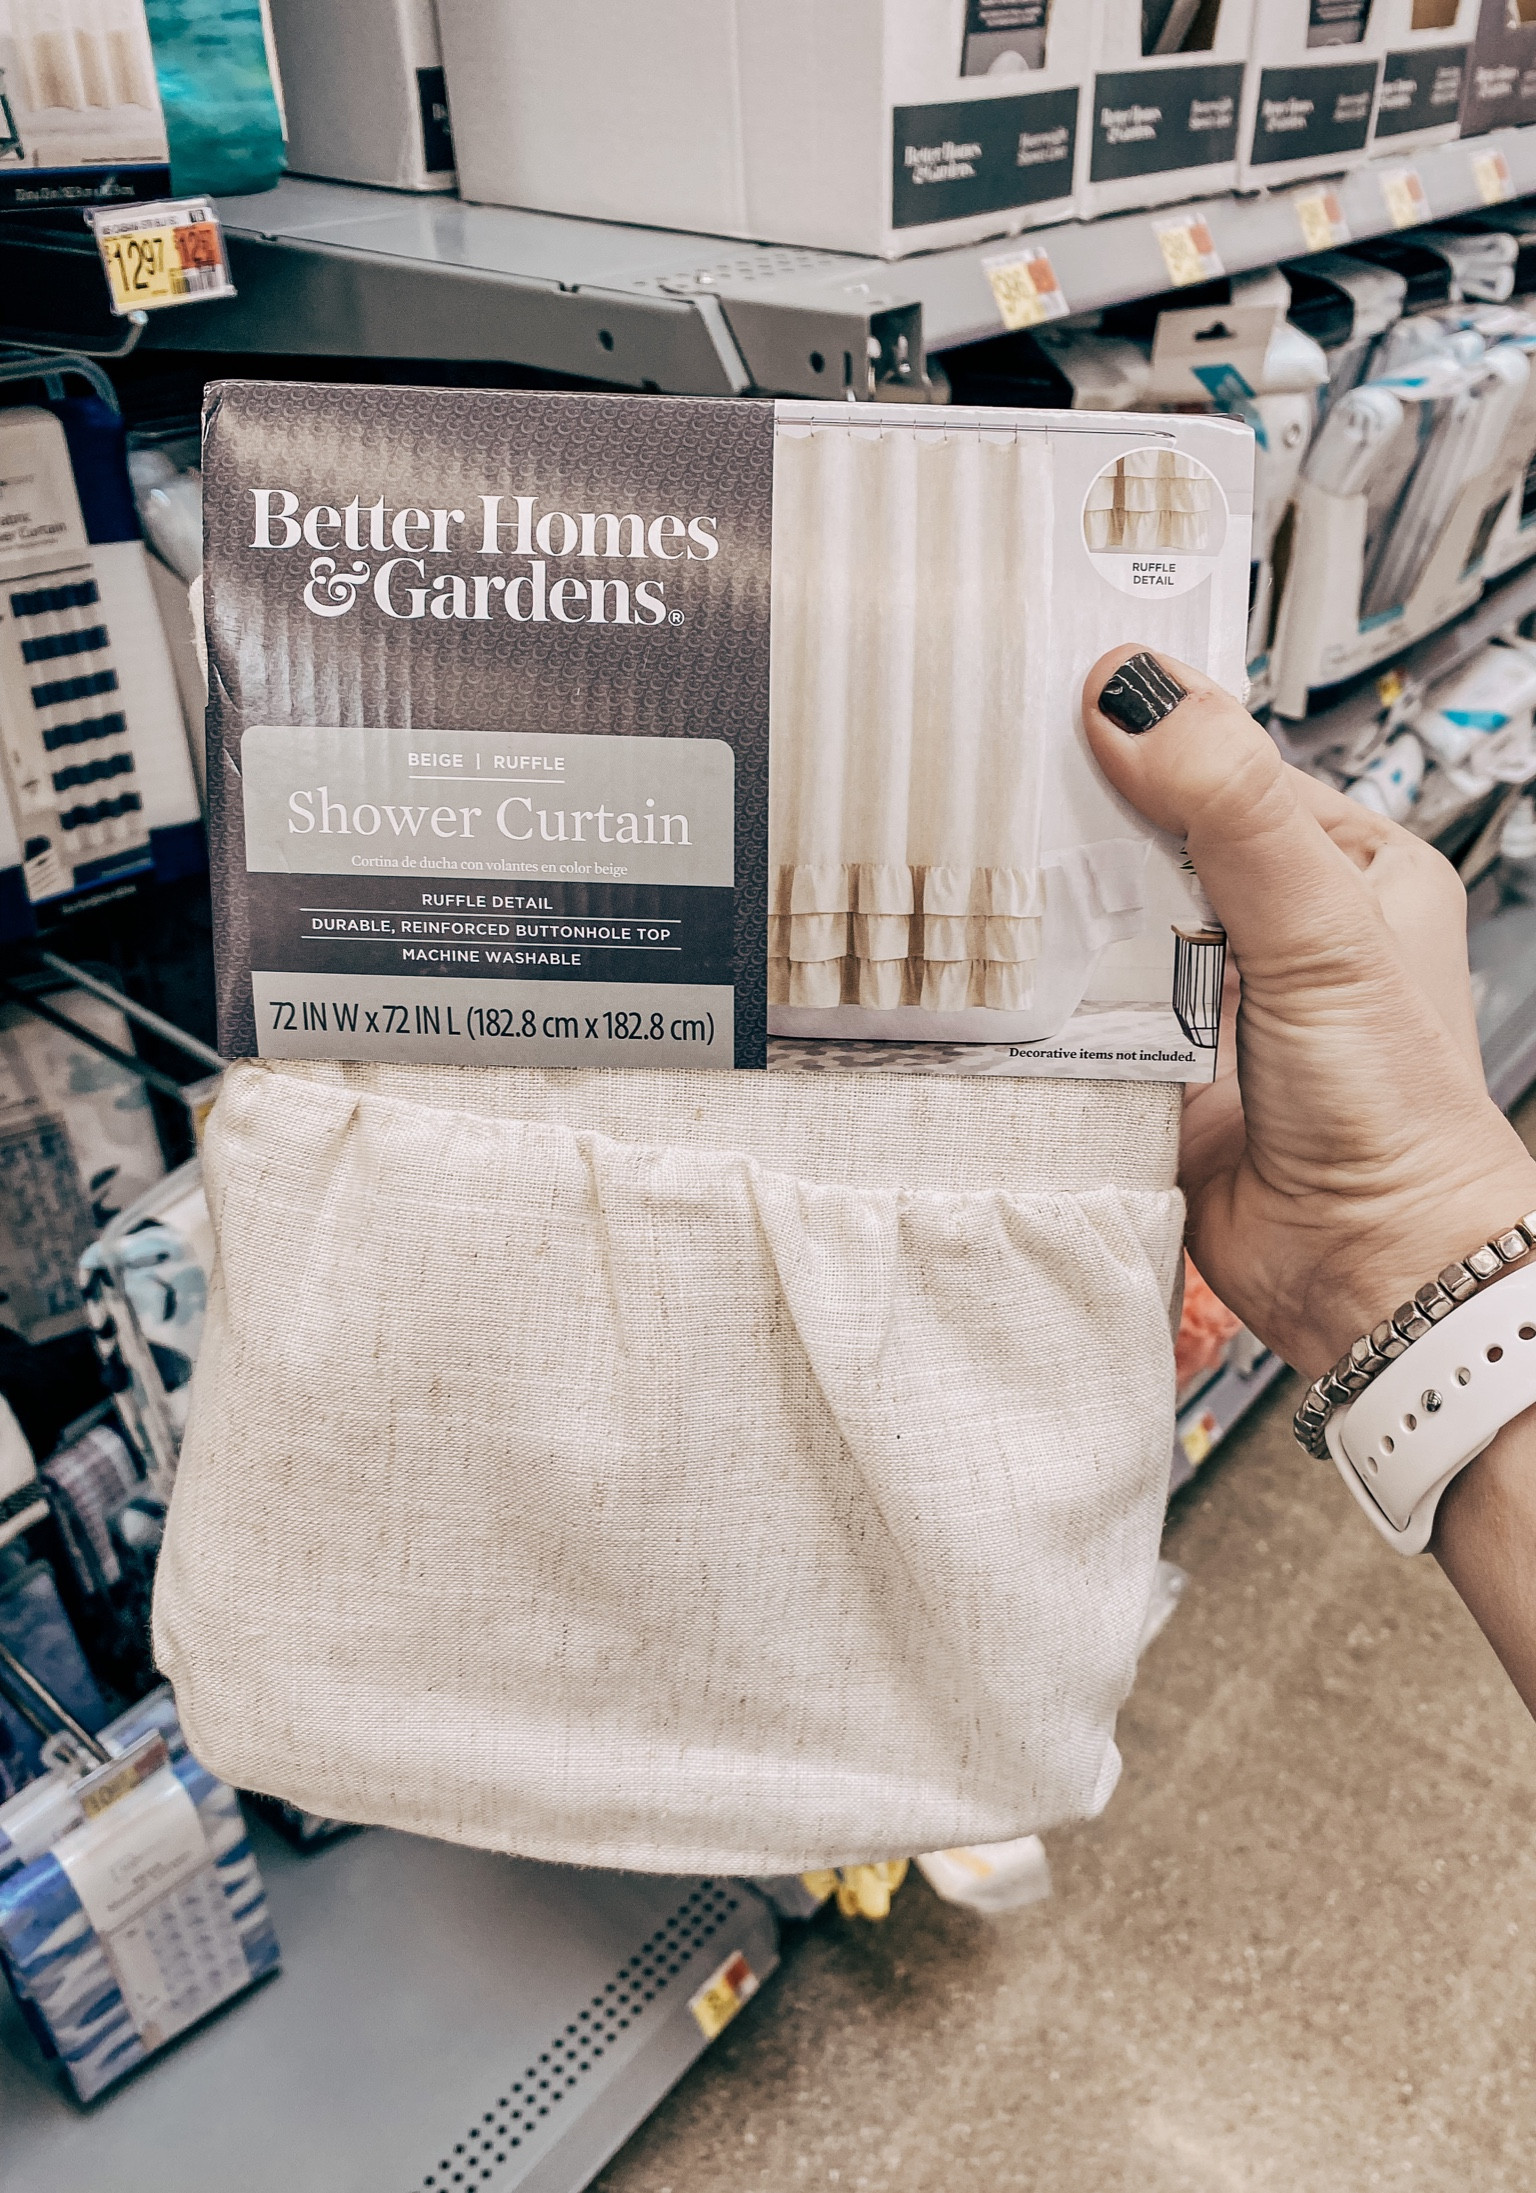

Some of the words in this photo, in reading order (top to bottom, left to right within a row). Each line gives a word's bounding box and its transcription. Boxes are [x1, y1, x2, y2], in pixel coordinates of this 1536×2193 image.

[248, 488, 466, 554] Better
[476, 495, 719, 561] Homes
[1132, 562, 1177, 573] RUFFLE
[1133, 575, 1175, 586] DETAIL
[408, 752, 464, 768] BEIGE
[494, 754, 566, 771] RUFFLE
[288, 786, 482, 838] Shower
[496, 797, 693, 846] Curtain
[351, 854, 399, 868] Cortina
[401, 855, 417, 869] de
[418, 856, 459, 870] ducha
[460, 861, 484, 871] con
[485, 858, 540, 873] volantes
[541, 863, 558, 873] en
[559, 860, 593, 875] color
[594, 861, 629, 878] beige
[422, 893, 487, 908] RUFFLE
[492, 895, 554, 910] DETAIL
[311, 918, 396, 935] DURABLE,
[401, 920, 511, 937] REINFORCED
[516, 923, 632, 940] BUTTONHOLE
[637, 927, 672, 941] TOP
[402, 948, 480, 963] MACHINE
[485, 951, 582, 966] WASHABLE
[269, 1001, 298, 1032] 72
[302, 1001, 328, 1032] IN
[332, 1002, 360, 1034] W
[382, 1004, 411, 1035] 72
[415, 1005, 441, 1036] IN
[445, 1006, 462, 1037] L
[466, 1006, 537, 1042] (182.8
[541, 1015, 580, 1040] cm
[584, 1016, 600, 1040] x
[602, 1010, 666, 1042] 182.8
[670, 1011, 716, 1047] cm)
[1009, 1047, 1077, 1060] Decorative
[1079, 1048, 1114, 1061] items
[1116, 1050, 1137, 1061] not
[1139, 1050, 1197, 1063] included.
